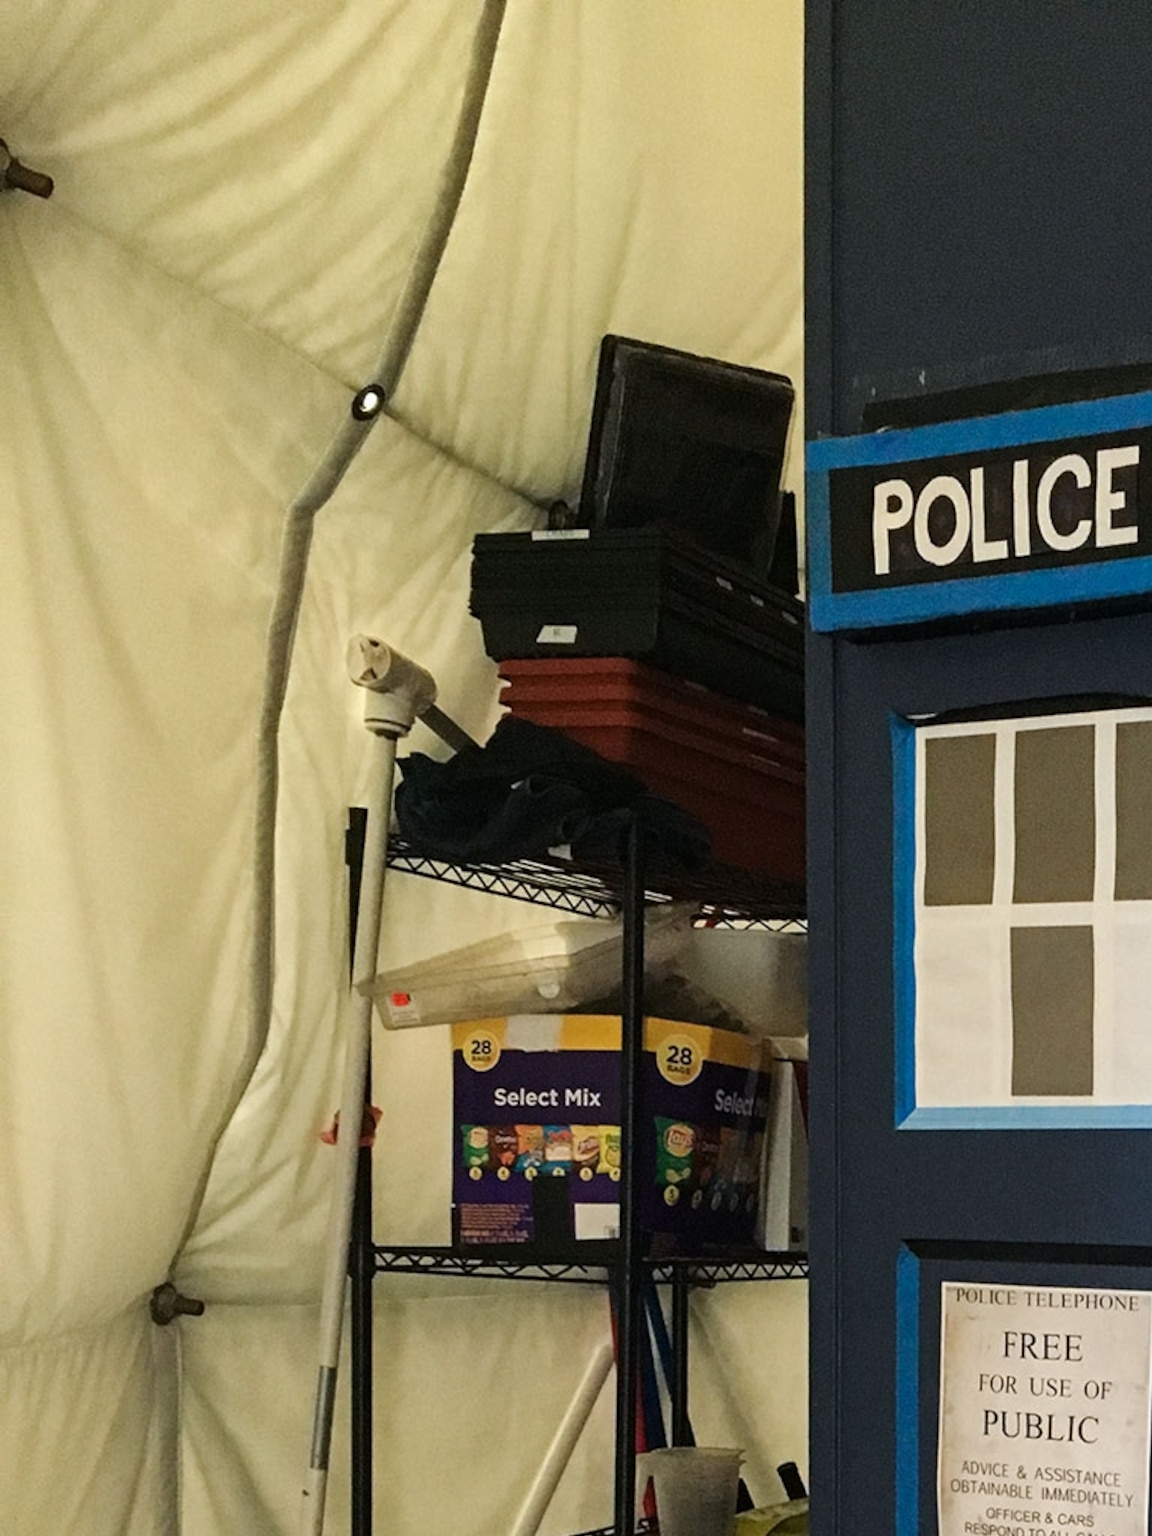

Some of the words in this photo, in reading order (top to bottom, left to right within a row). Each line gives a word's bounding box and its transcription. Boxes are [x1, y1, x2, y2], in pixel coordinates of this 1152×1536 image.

[873, 445, 1140, 575] POLICE
[471, 1040, 492, 1055] 28
[666, 1045, 692, 1065] 28
[494, 1088, 559, 1107] Select
[565, 1088, 601, 1107] Mix
[714, 1089, 753, 1116] Select
[956, 1288, 1017, 1305] POLICE
[1024, 1291, 1140, 1311] TELEPHONE
[1003, 1331, 1083, 1362] FREE
[978, 1373, 1018, 1394] FOR
[1029, 1376, 1072, 1397] USE
[1084, 1380, 1112, 1400] OF
[983, 1409, 1099, 1444] PUBLIC
[961, 1460, 1009, 1478] ADVICE
[1016, 1465, 1027, 1480] &
[1035, 1467, 1121, 1488] ASSISTANCE
[950, 1478, 1033, 1500] OBTAINABLE
[1041, 1486, 1134, 1508] IMMEDIATELY
[986, 1506, 1041, 1524] OFFICER
[1044, 1513, 1053, 1524] &
[1057, 1513, 1095, 1527] CARS
